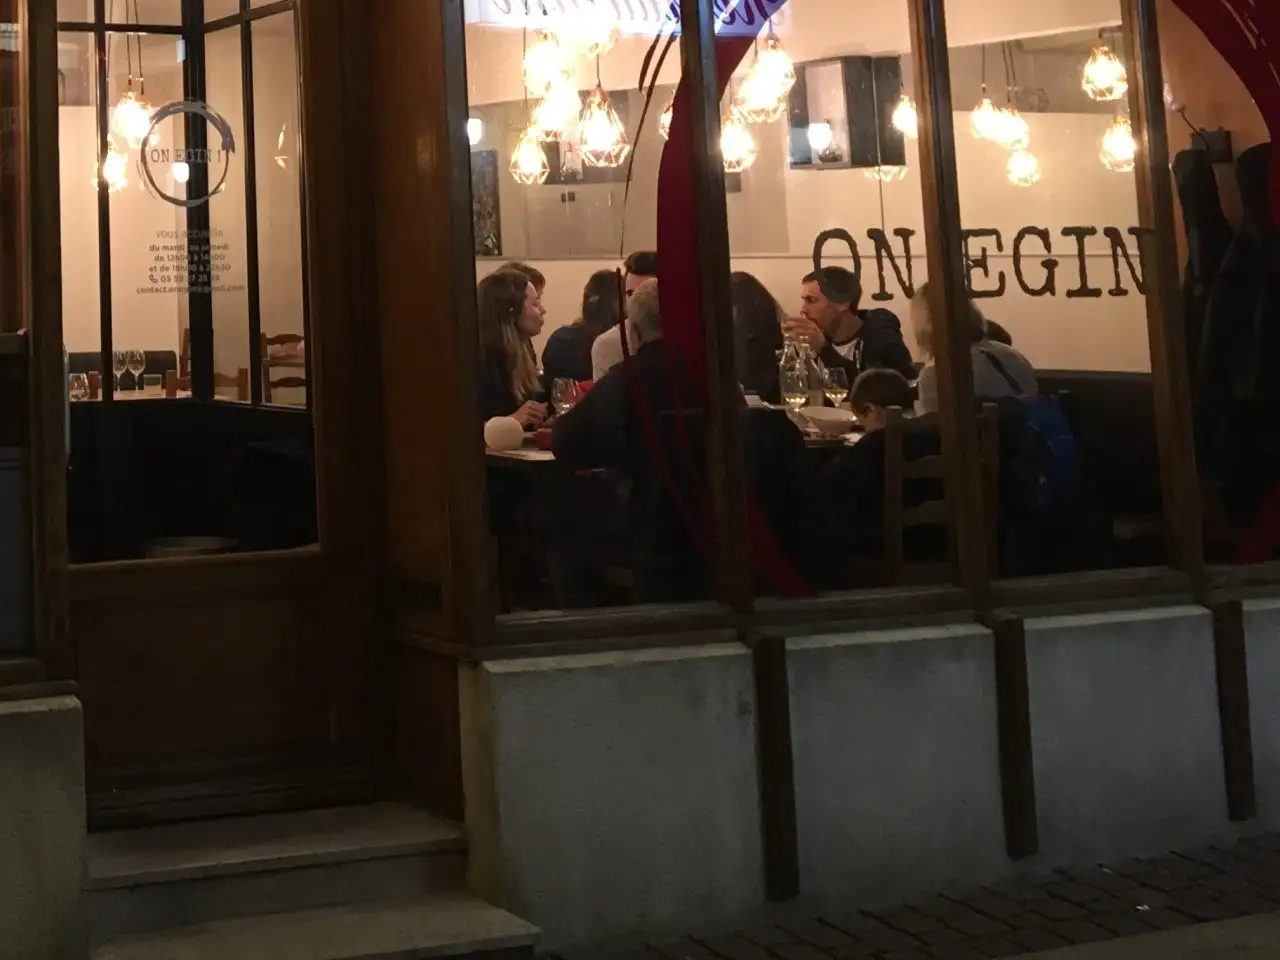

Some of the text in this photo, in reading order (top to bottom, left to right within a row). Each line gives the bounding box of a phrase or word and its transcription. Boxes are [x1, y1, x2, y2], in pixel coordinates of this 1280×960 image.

[150, 148, 170, 163] ON
[149, 244, 159, 252] du
[154, 254, 165, 262] de
[812, 225, 1155, 301] ON EGIN
